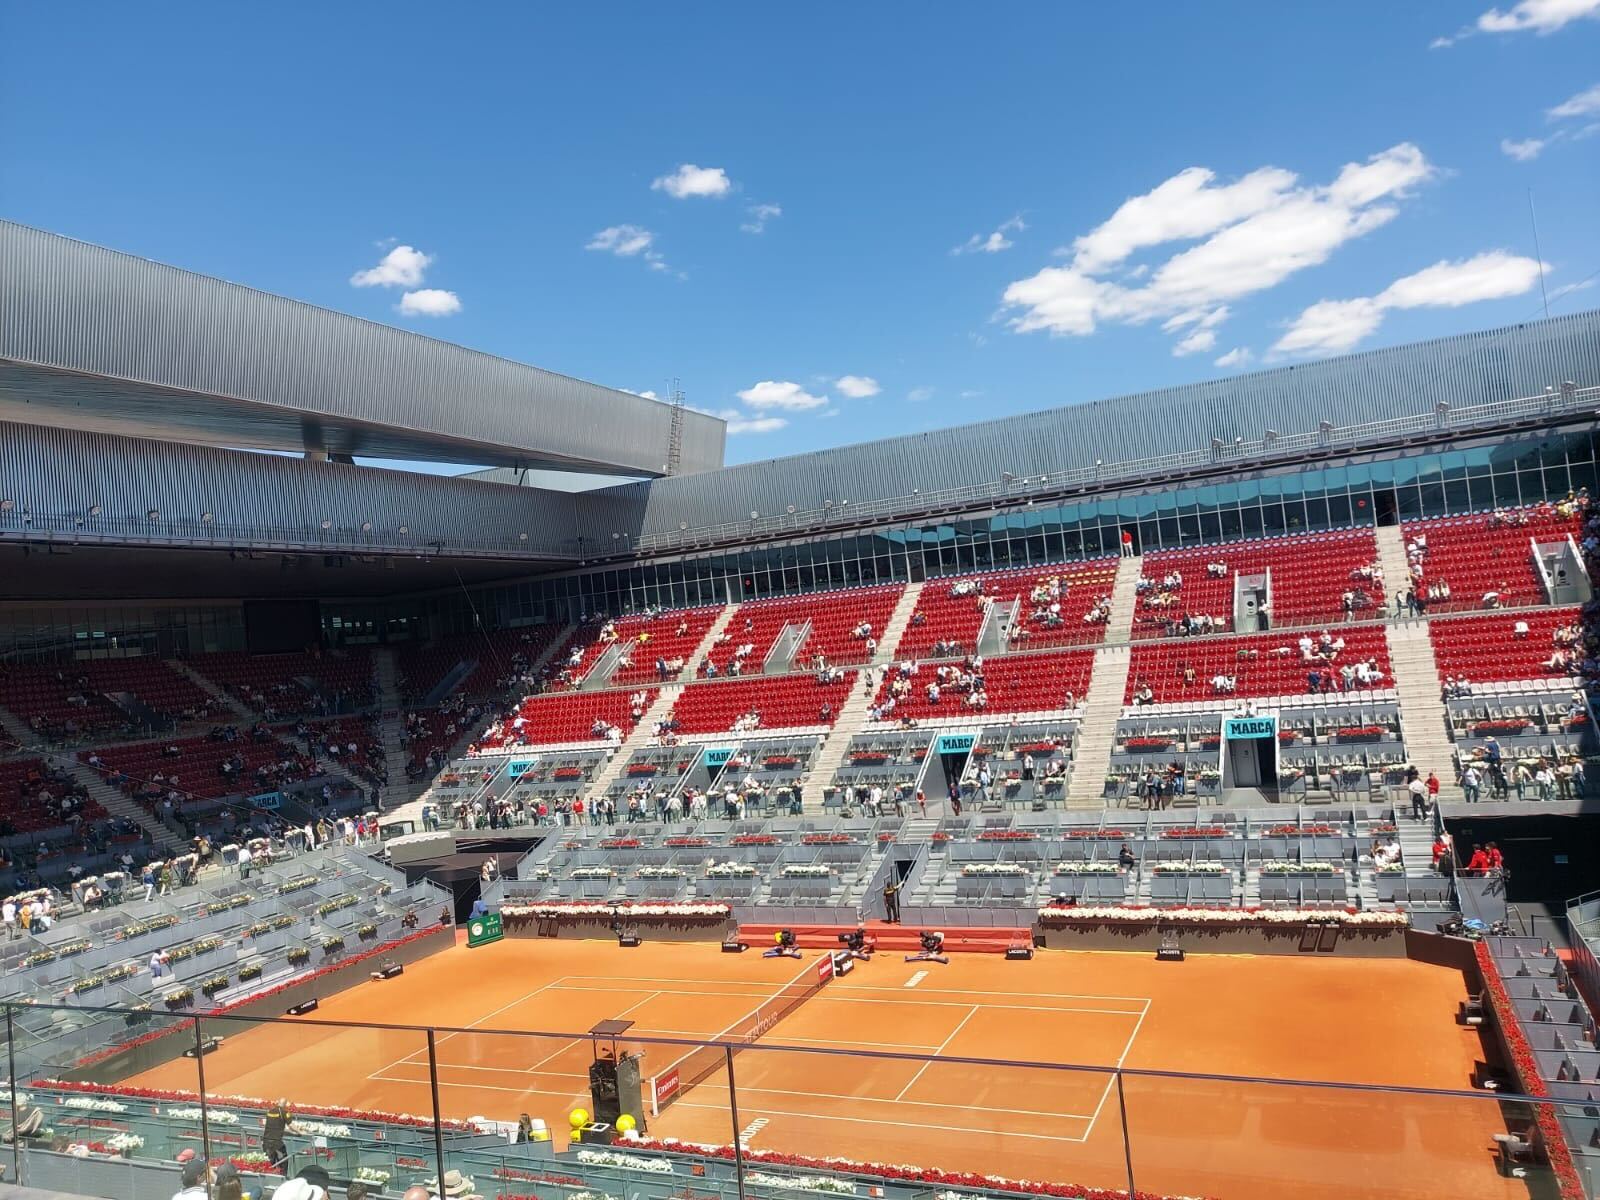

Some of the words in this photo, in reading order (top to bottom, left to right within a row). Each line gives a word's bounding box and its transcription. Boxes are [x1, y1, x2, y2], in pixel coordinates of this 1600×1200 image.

[1231, 721, 1273, 735] MARCA
[708, 752, 731, 762] MARC
[657, 1075, 679, 1097] Emirates
